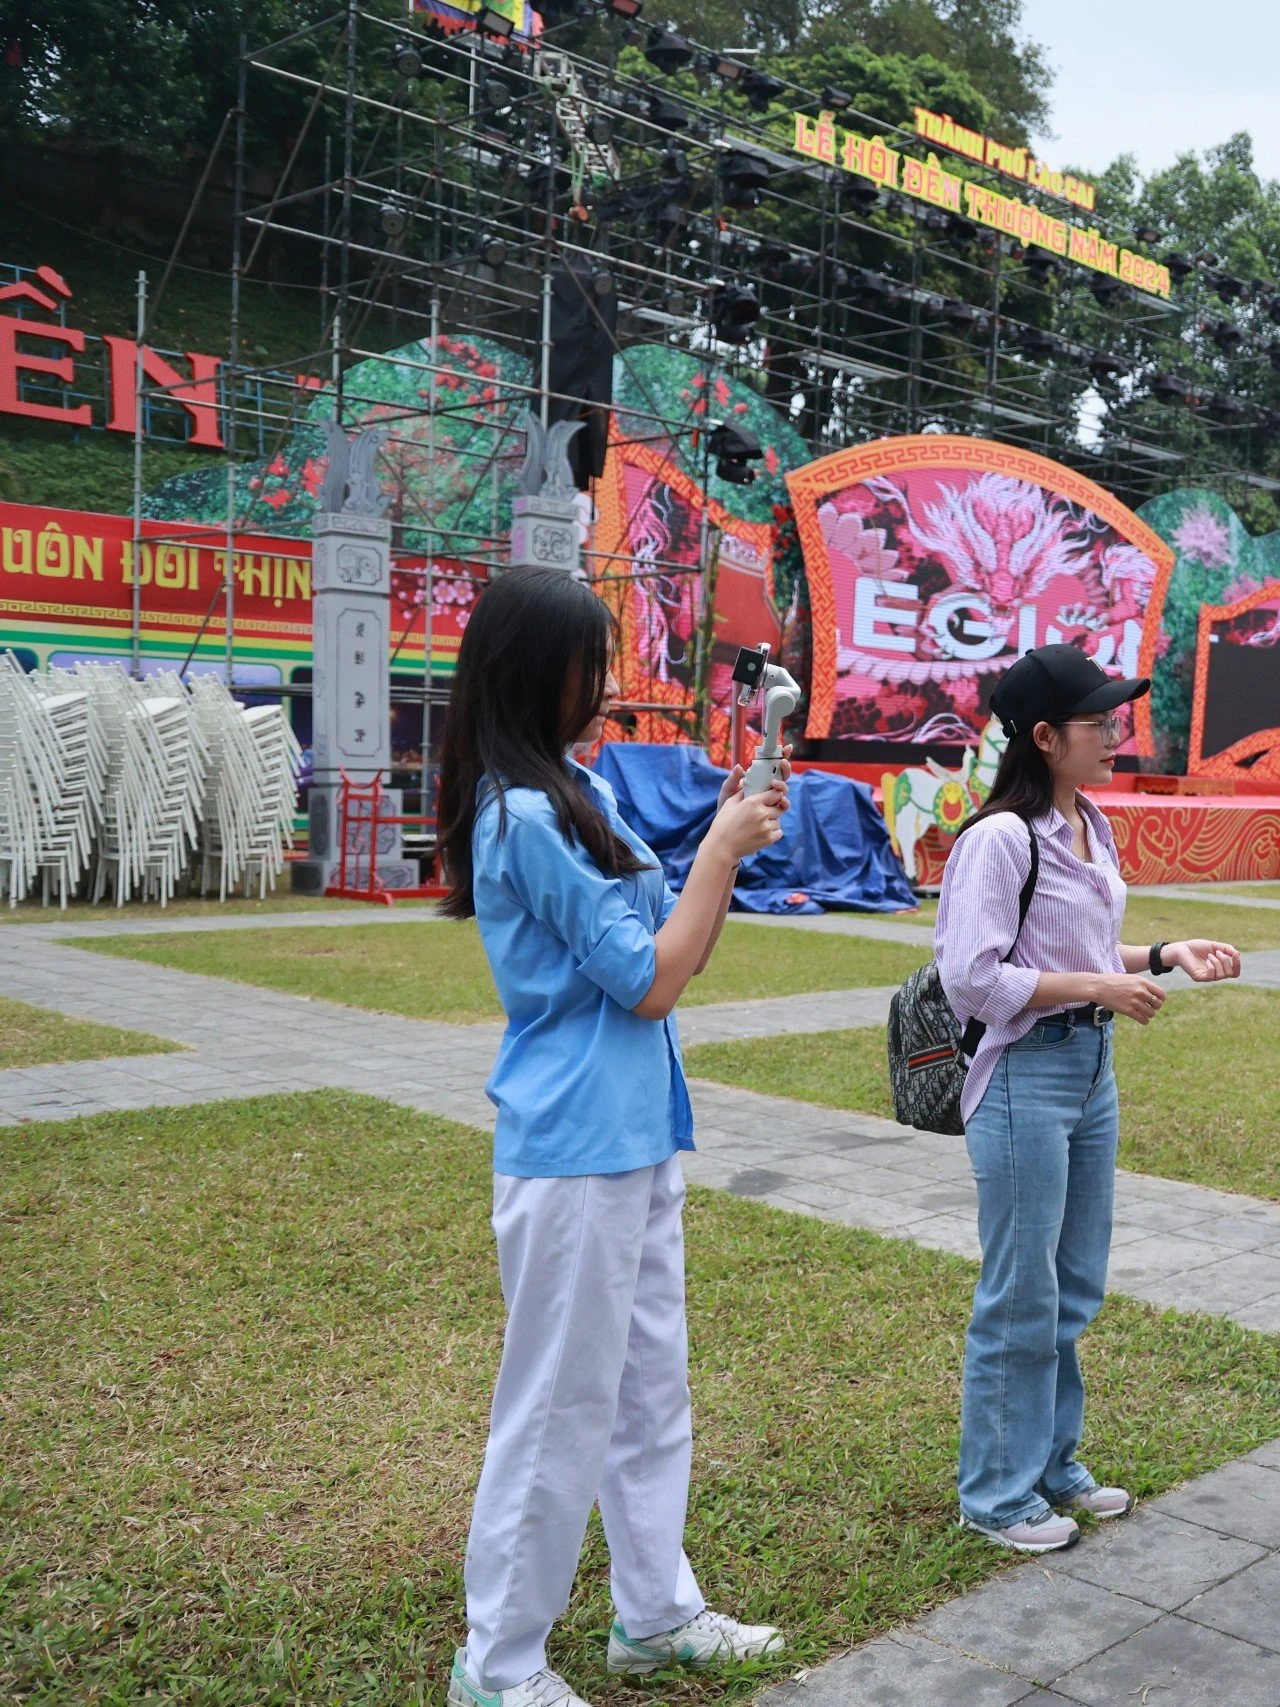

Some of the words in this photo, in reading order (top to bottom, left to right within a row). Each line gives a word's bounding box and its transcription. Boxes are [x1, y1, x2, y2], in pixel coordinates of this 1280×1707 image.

[793, 110, 836, 164] LỄ
[841, 131, 901, 190] HỘI
[900, 152, 963, 214] ĐỀN
[964, 181, 1067, 256] THƯỢNG
[1067, 225, 1118, 275] NĂM
[1119, 249, 1170, 299] 2024
[914, 106, 986, 162] THÀNH
[986, 138, 1027, 180] PHỐ
[1027, 158, 1064, 195] LÀO
[1064, 174, 1096, 211] CAI
[214, 550, 312, 608] THỊN
